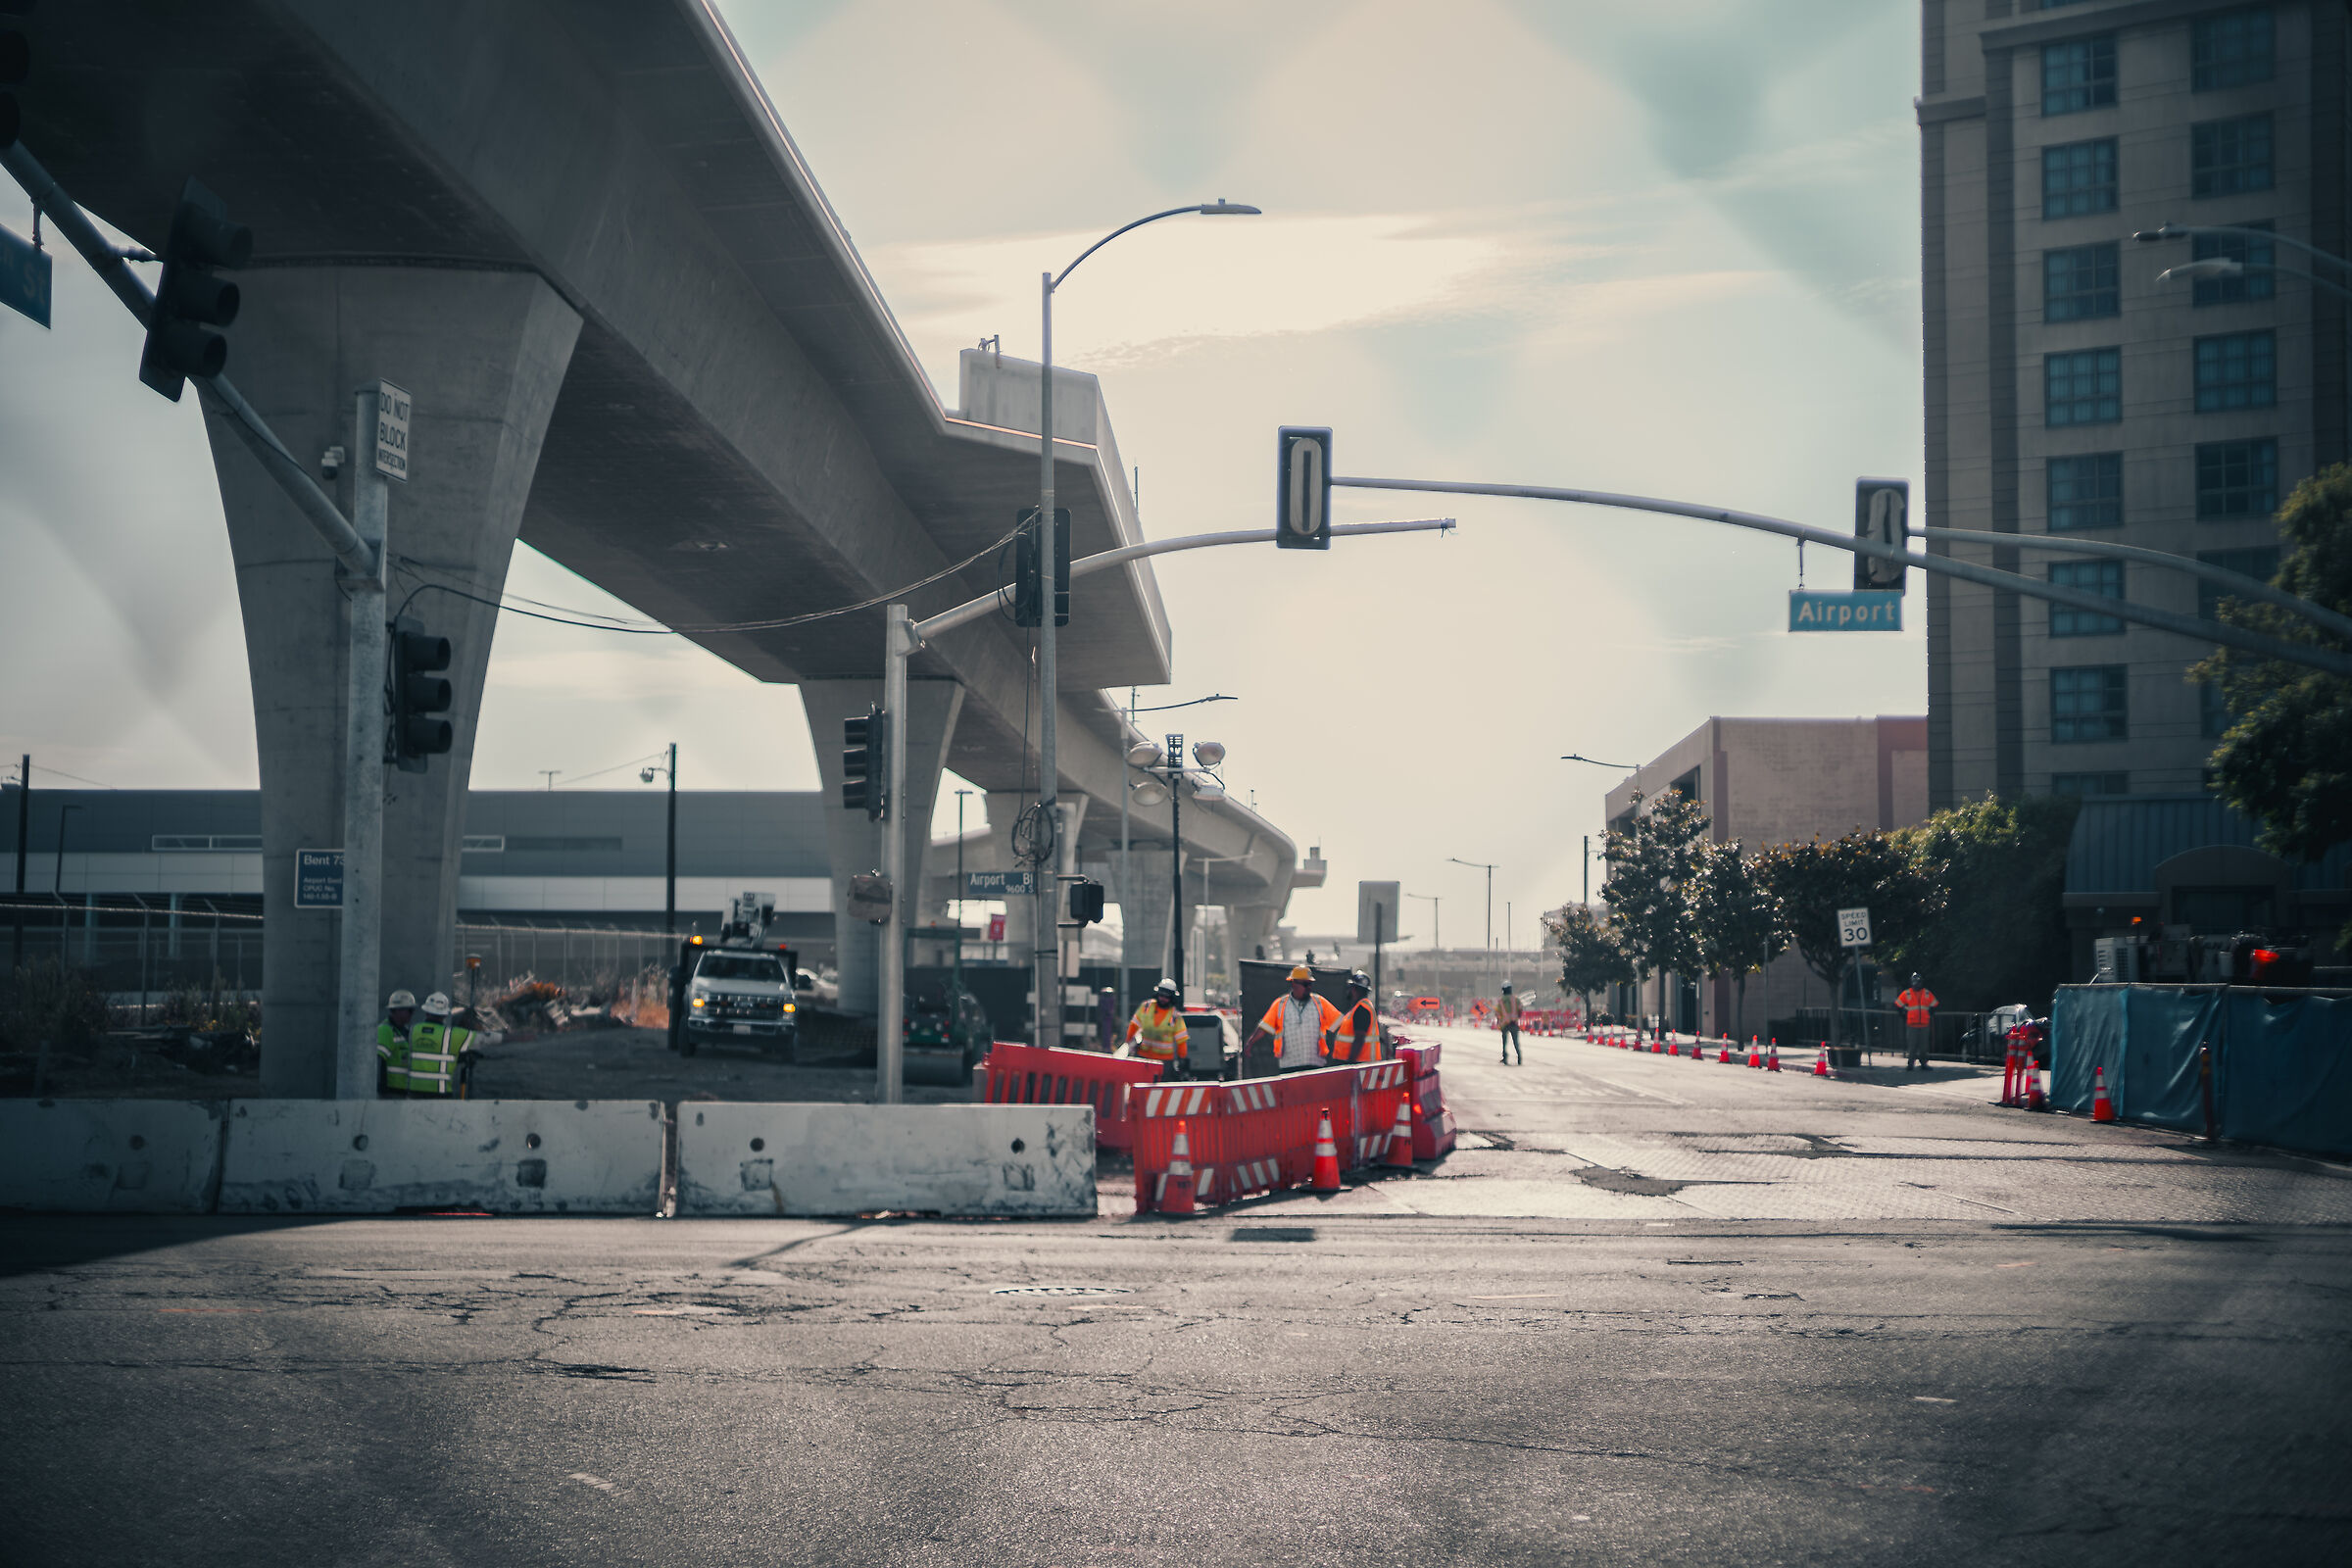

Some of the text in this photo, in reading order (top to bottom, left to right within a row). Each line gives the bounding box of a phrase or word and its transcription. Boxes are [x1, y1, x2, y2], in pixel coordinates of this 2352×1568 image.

[23, 260, 47, 307] St
[379, 392, 409, 422] DO NOT
[379, 421, 406, 452] BLOCK
[1797, 600, 1896, 626] Airport
[304, 854, 330, 866] Bent
[970, 872, 1005, 888] Airport
[1004, 884, 1035, 894] 9600 S
[1844, 927, 1868, 942] 30
